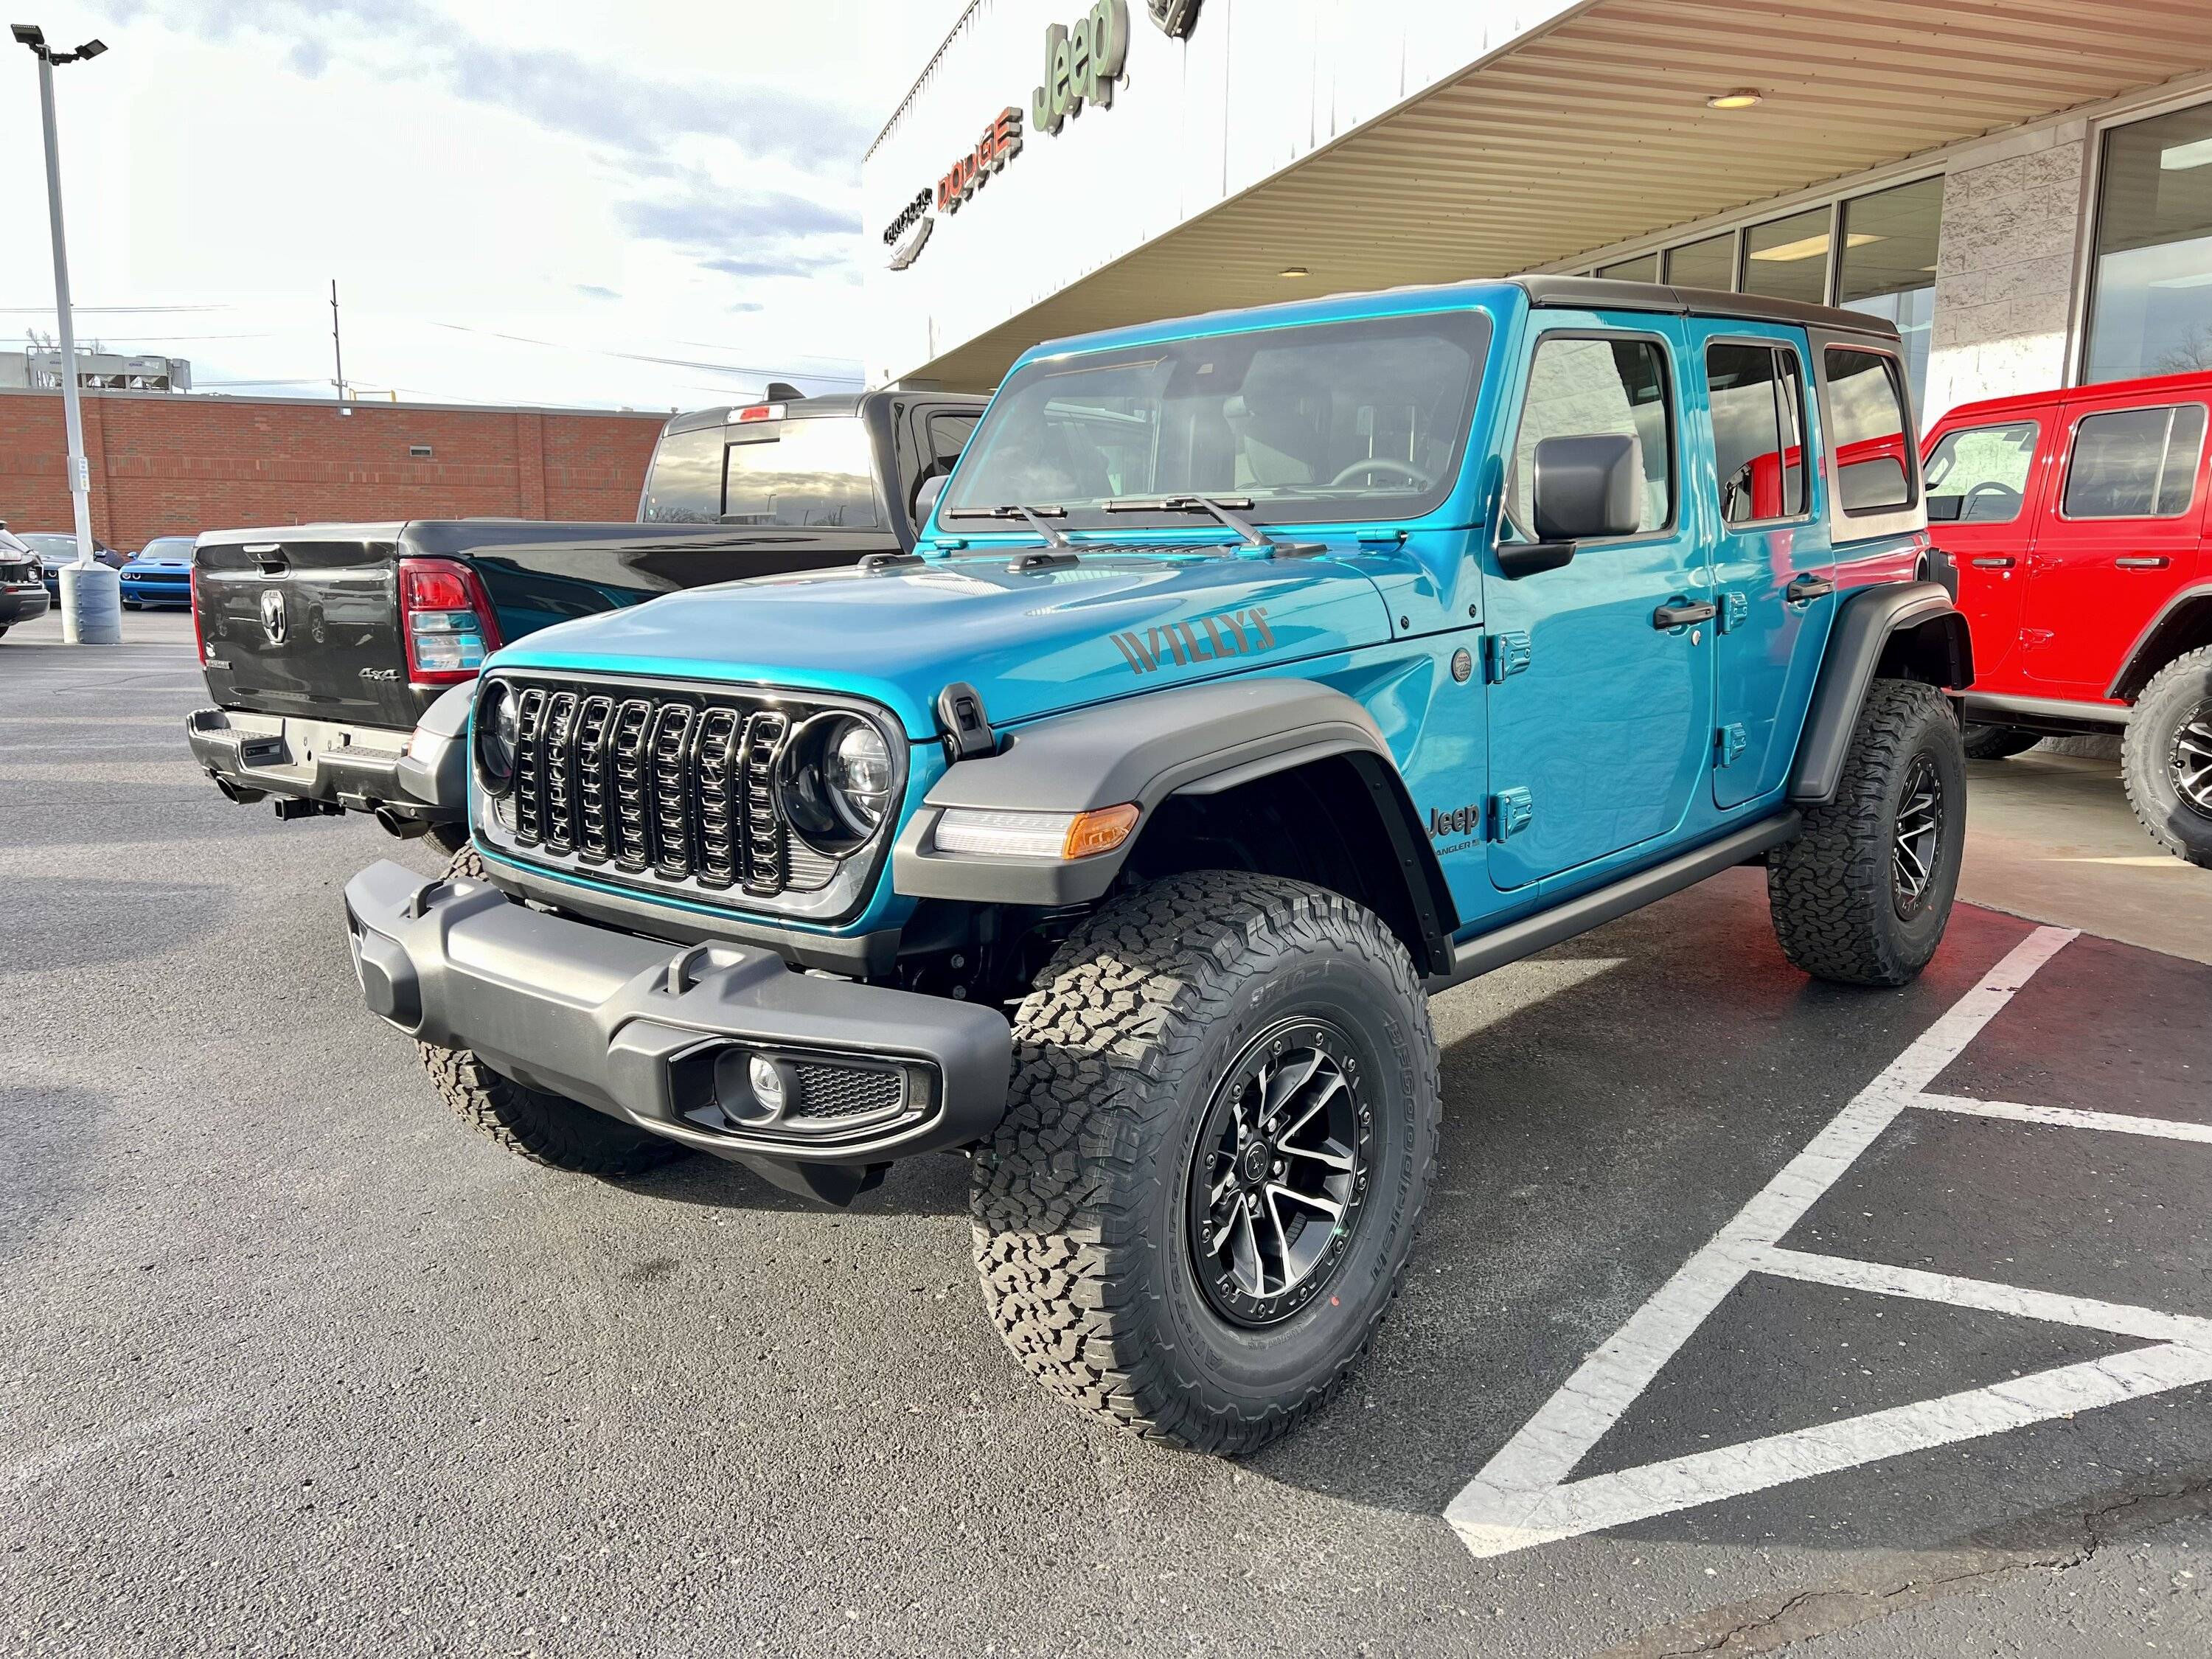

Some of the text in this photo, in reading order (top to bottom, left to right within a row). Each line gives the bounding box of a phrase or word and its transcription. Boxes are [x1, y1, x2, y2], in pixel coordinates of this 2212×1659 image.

[1032, 0, 1128, 137] Jeep
[937, 106, 1023, 214] DODGE
[1109, 607, 1275, 675] WILLYS
[1425, 804, 1479, 840] Jeep
